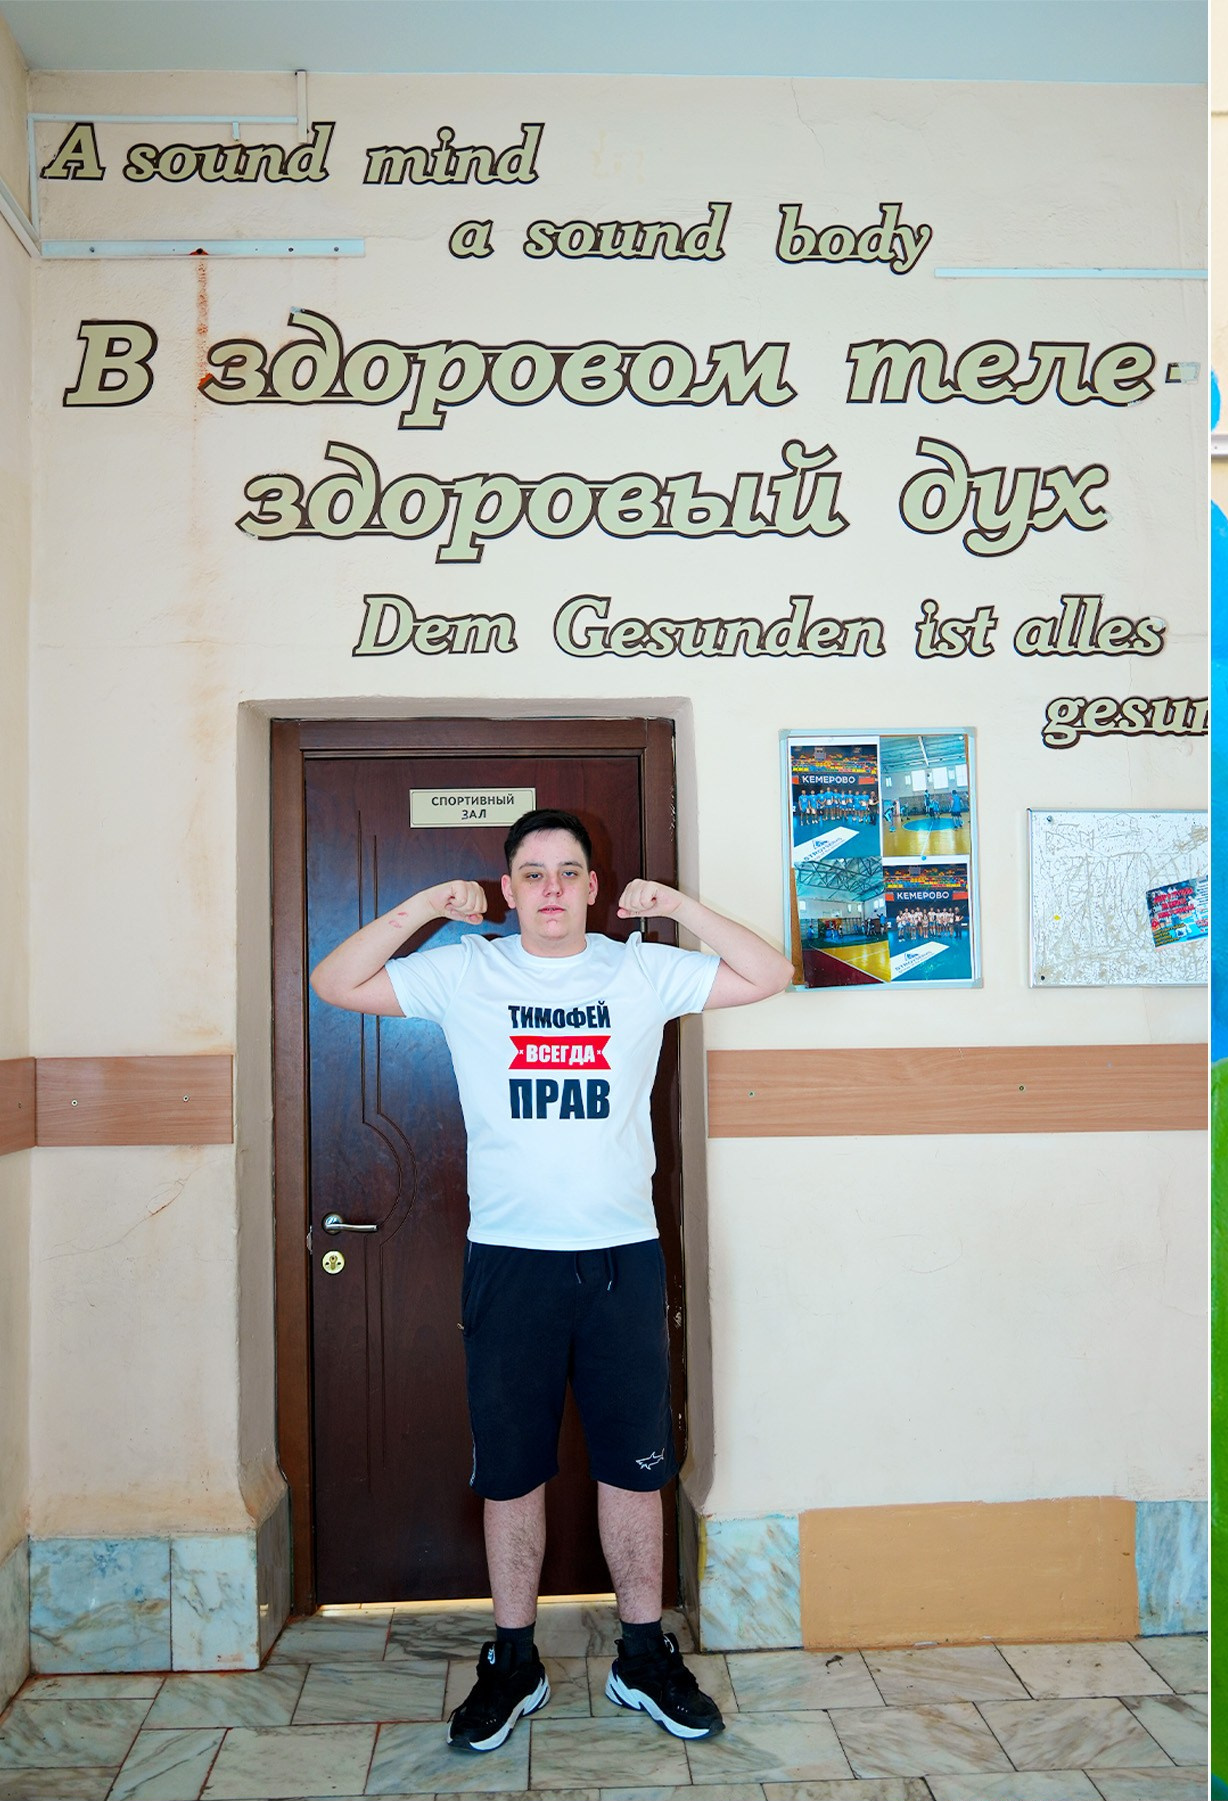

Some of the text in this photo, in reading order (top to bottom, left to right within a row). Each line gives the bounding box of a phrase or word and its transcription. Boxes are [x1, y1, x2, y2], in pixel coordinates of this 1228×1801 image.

[41, 121, 545, 185] A sound mind
[449, 202, 932, 275] a sound body
[63, 319, 159, 408] В
[198, 306, 798, 430] здоровом
[235, 435, 1113, 564] здоровый дух
[352, 593, 1167, 659] Dem Gesunden ist alles
[801, 775, 856, 784] КЕМЕРОВО
[430, 793, 515, 807] СПОРТИВНЫЙ
[461, 808, 487, 820] ЗАЛ
[896, 891, 950, 900] КЕМЕРОВО
[508, 1001, 612, 1029] ТИМОФЕЙ
[525, 1043, 597, 1066] ВСЕГДА
[508, 1078, 612, 1120] ПРАВ
